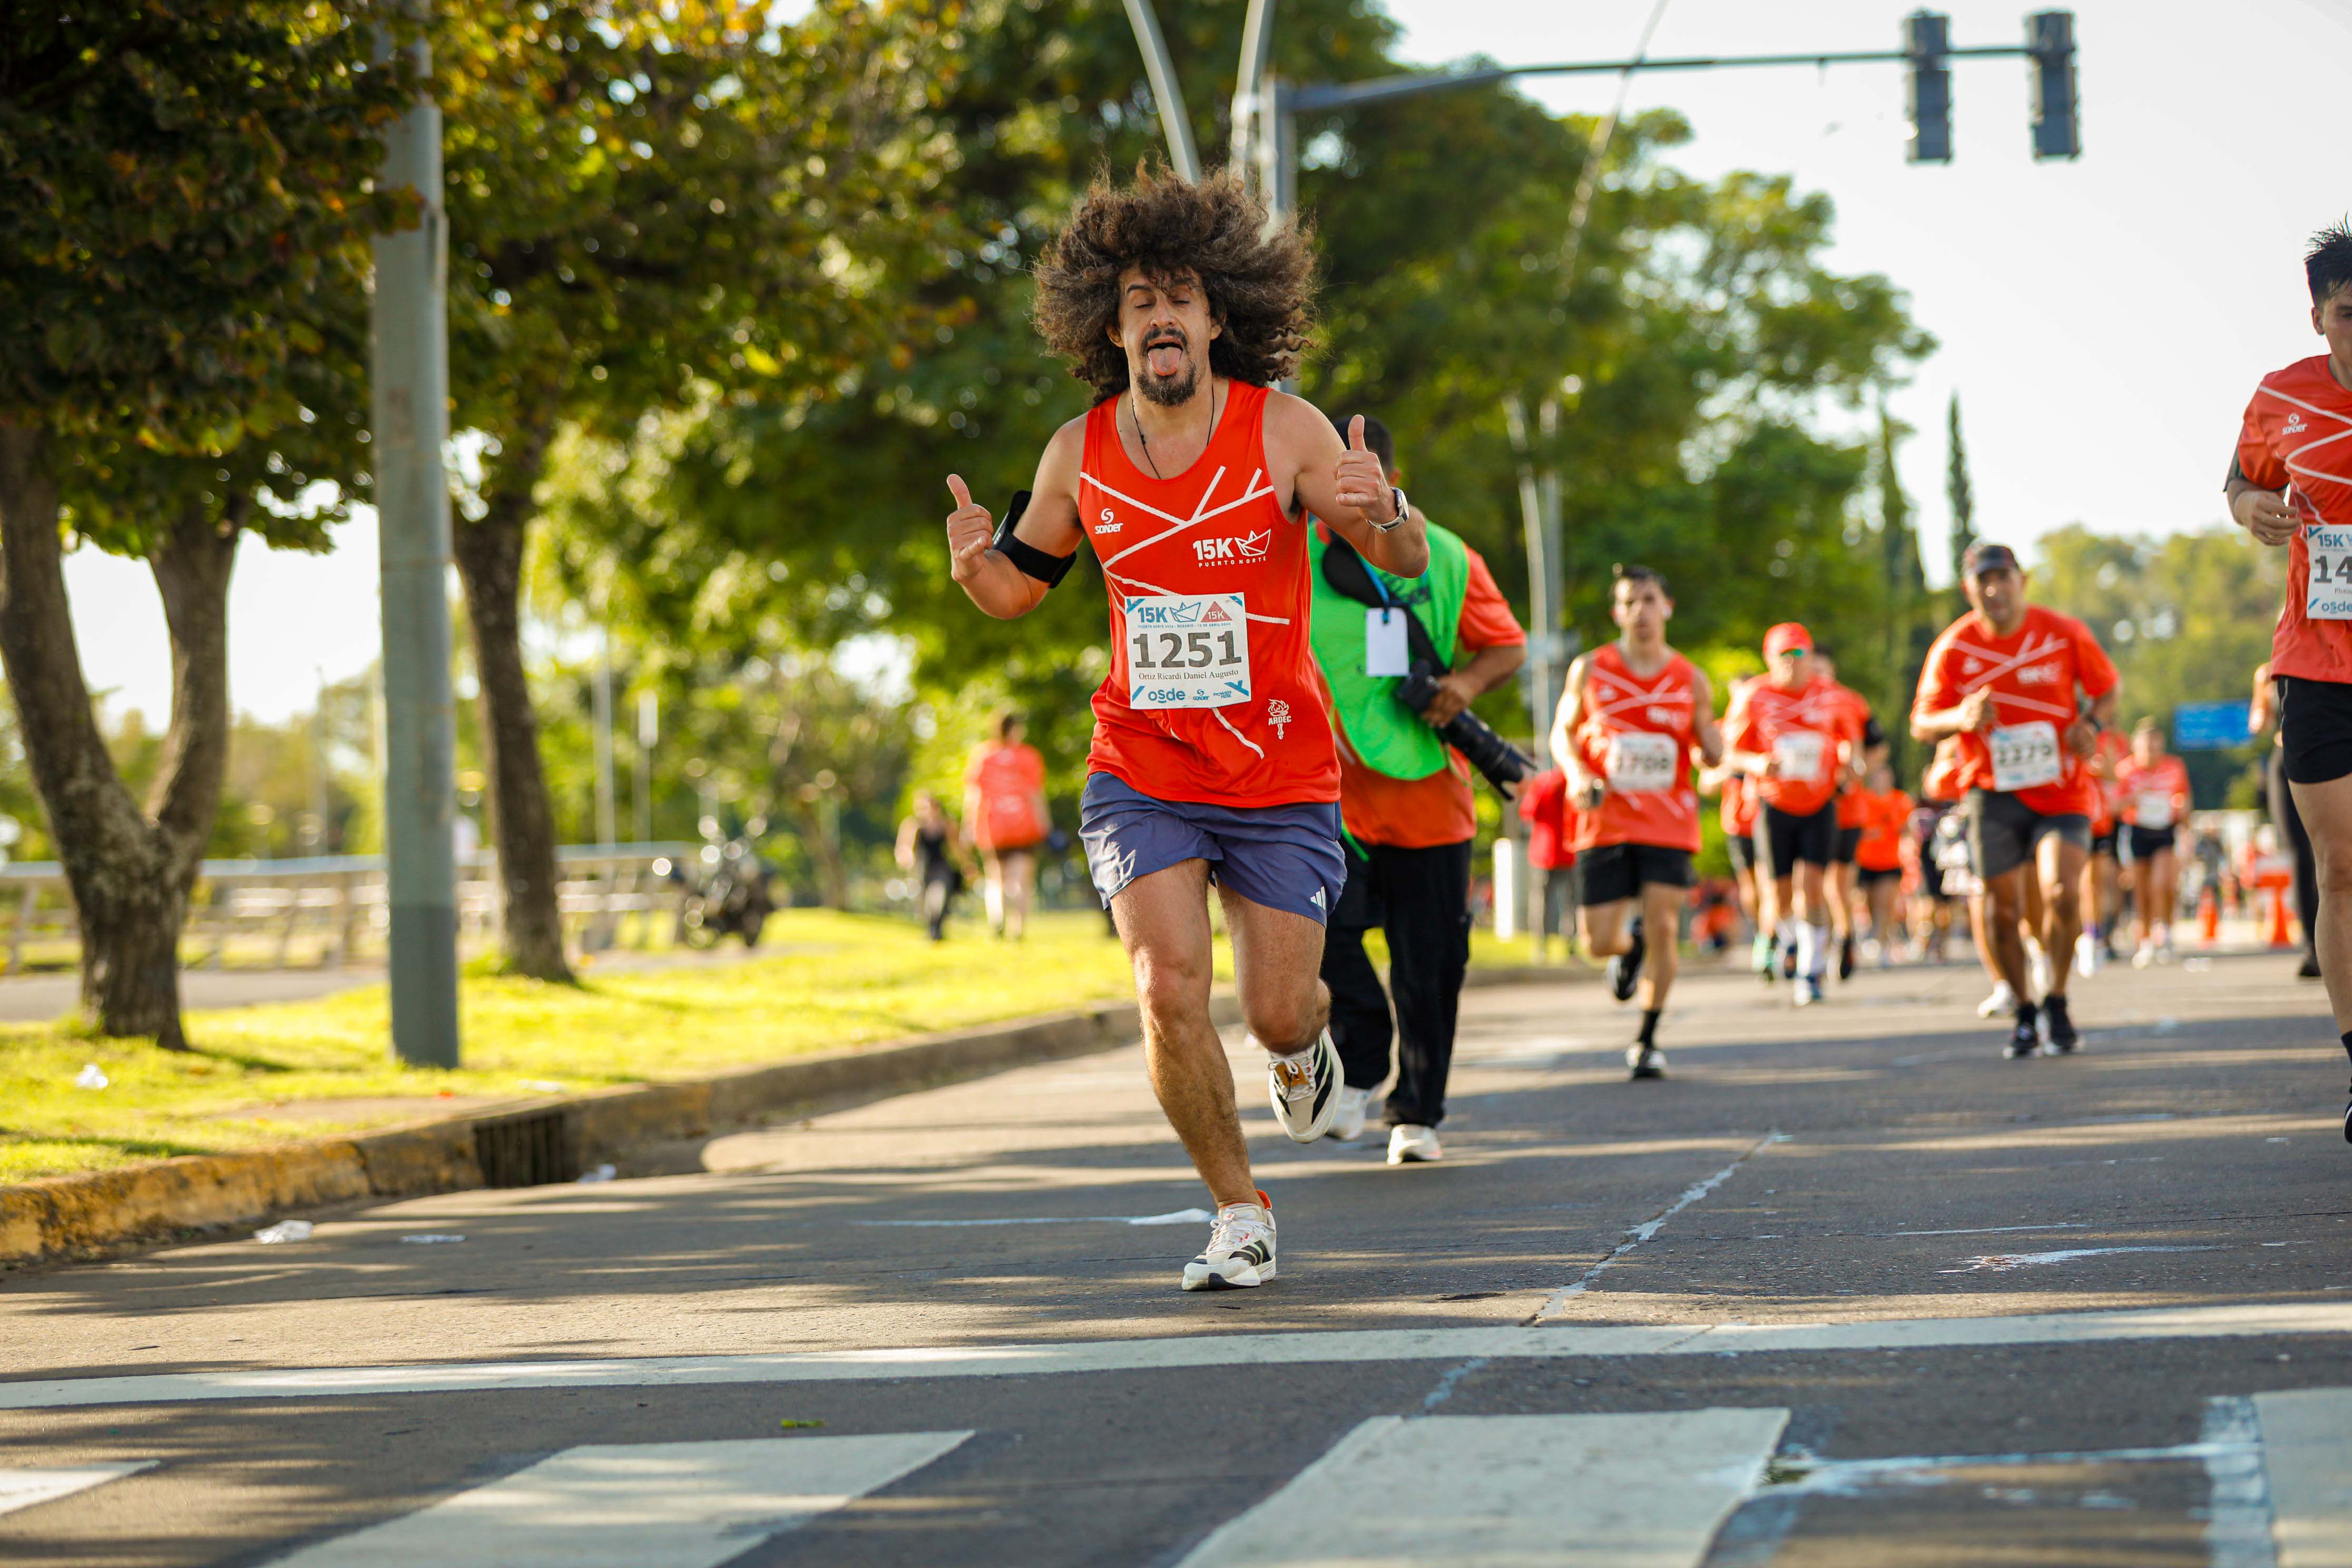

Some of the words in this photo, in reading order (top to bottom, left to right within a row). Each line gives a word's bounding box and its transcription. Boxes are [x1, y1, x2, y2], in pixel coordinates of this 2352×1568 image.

[2317, 534, 2344, 547] 15K
[1193, 537, 1234, 560] 15K
[2314, 555, 2352, 584] 14
[2321, 601, 2352, 613] osde
[1138, 607, 1168, 623] 15K
[1208, 611, 1225, 620] 15K
[1133, 630, 1242, 668] 1251
[1209, 670, 1239, 679] Augusto
[1148, 687, 1185, 703] osde
[1268, 716, 1291, 726] ARDEC
